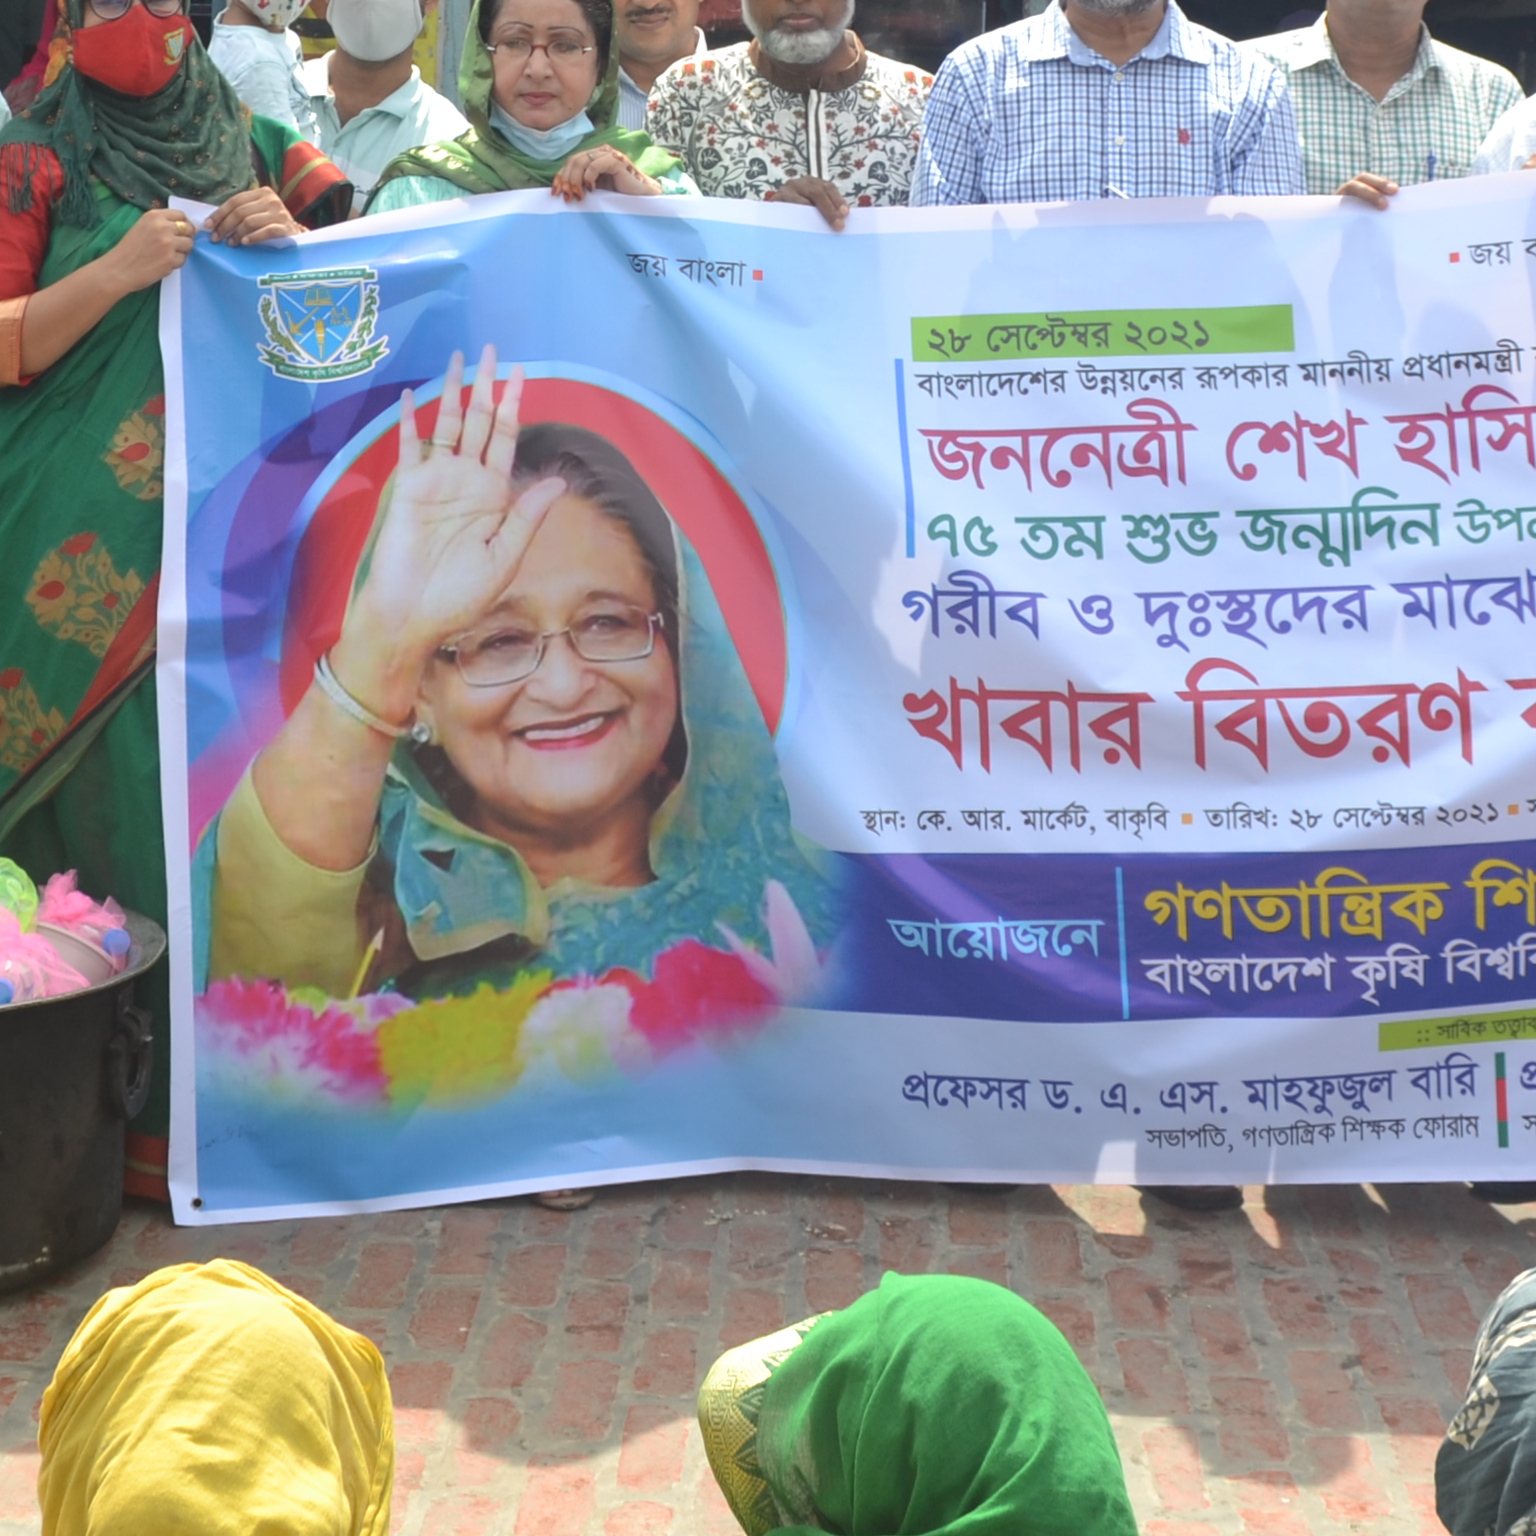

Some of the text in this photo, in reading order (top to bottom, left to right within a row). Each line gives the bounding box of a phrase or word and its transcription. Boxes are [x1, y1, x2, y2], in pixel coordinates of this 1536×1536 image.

[626, 254, 747, 287] জয় বাংলা
[1467, 241, 1513, 266] জয়
[928, 315, 1210, 357] ২৮ সেপ্টেম্বর ২০২১
[914, 368, 1065, 399] বাংলাদেশের
[1076, 363, 1185, 398] উন্নয়নের
[1195, 362, 1289, 392] রূপকার
[1297, 350, 1393, 385] মাননীয়
[1402, 338, 1524, 382] প্রধানমন্ত্রী
[917, 397, 1198, 492] জননেত্রী
[1226, 408, 1369, 482] শেখ
[927, 512, 998, 557] ৭৫
[1015, 515, 1106, 560] তম
[1123, 511, 1220, 564] শুভ
[1236, 486, 1441, 567] জন্মদিন
[901, 569, 1048, 640] গরীব
[1067, 593, 1115, 636] ও
[1134, 582, 1375, 654] দুঃস্থদের
[901, 675, 1156, 774] খাবার
[1174, 657, 1489, 773] বিতরণ
[916, 808, 952, 833] কে.
[961, 808, 1010, 833] আর.
[1105, 802, 1168, 841] বাকৃবি
[1290, 809, 1323, 833] ২৮
[1332, 800, 1426, 830] সেপ্টেম্বর
[1435, 802, 1499, 827] ২০২১
[1144, 866, 1450, 943] গণতান্ত্রিক
[886, 915, 1106, 963] আয়োজনে
[1140, 952, 1336, 996] বাংলাদেশ
[1350, 939, 1431, 1006] কৃষি
[901, 1051, 1480, 1116] প্রফেসর ড. এ. এস. মাহফুজুল বারি
[1145, 1112, 1480, 1154] সভাপতি, গণতান্ত্রিক শিক্ষক ফোরাম
